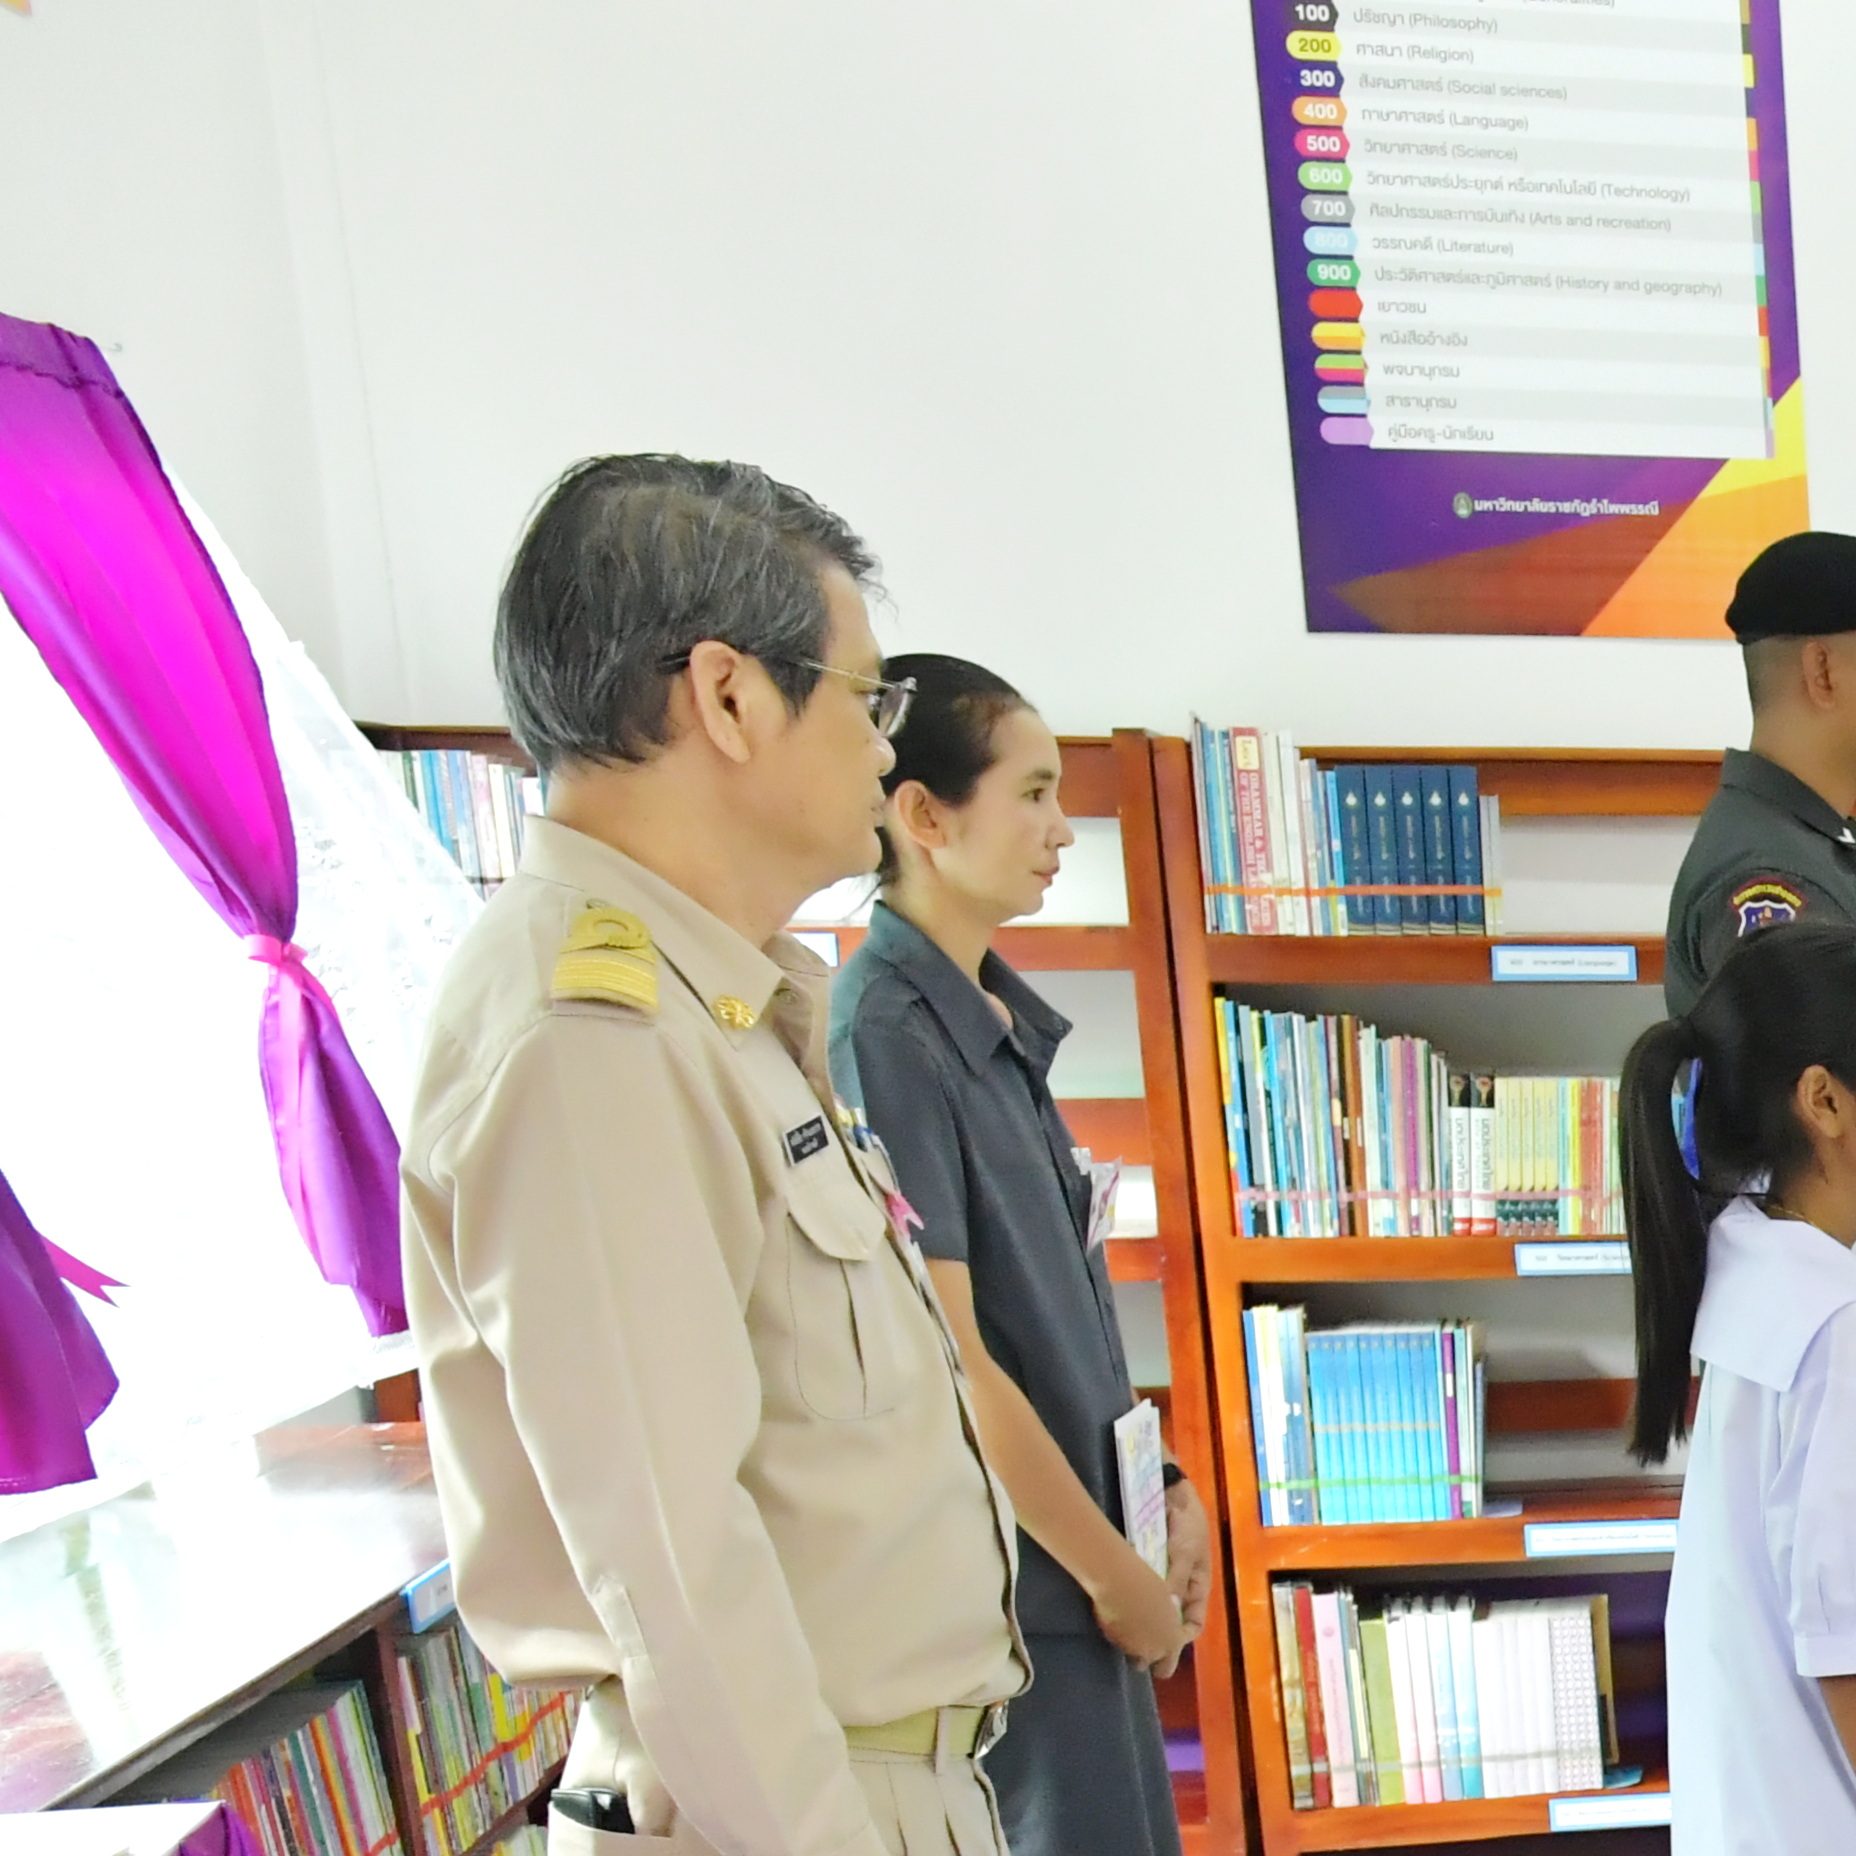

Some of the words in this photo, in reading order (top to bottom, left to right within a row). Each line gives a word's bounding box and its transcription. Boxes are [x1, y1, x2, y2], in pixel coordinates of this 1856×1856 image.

[1295, 3, 1331, 22] 100
[1408, 13, 1498, 34] (Philosophy)
[1298, 37, 1332, 53] 200
[1356, 43, 1403, 58] ศาสนา
[1406, 45, 1474, 64] (Religion)
[1300, 70, 1336, 87] 300
[1447, 79, 1496, 96] (Social
[1499, 83, 1568, 101] sciences)
[1303, 103, 1339, 120] 400
[1449, 112, 1529, 131] (Language)
[1306, 136, 1341, 152] 500
[1364, 138, 1447, 156] วิทยาศาสตร์
[1451, 144, 1518, 162] (Science)
[1309, 169, 1343, 184] 600
[1601, 183, 1690, 203] (Technology)
[1312, 200, 1346, 216] 700
[1529, 211, 1562, 227] (Arts
[1566, 214, 1593, 227] and
[1596, 216, 1671, 232] recreation)
[1437, 239, 1513, 255] (Literature)
[1317, 265, 1351, 281] 900
[1556, 275, 1610, 293] (History
[1614, 280, 1640, 292] and
[1643, 281, 1722, 298] geography)
[1377, 301, 1427, 314] เยาวชน
[1383, 364, 1460, 381] พจนานุกรม
[1385, 395, 1457, 412] สารานุกรม
